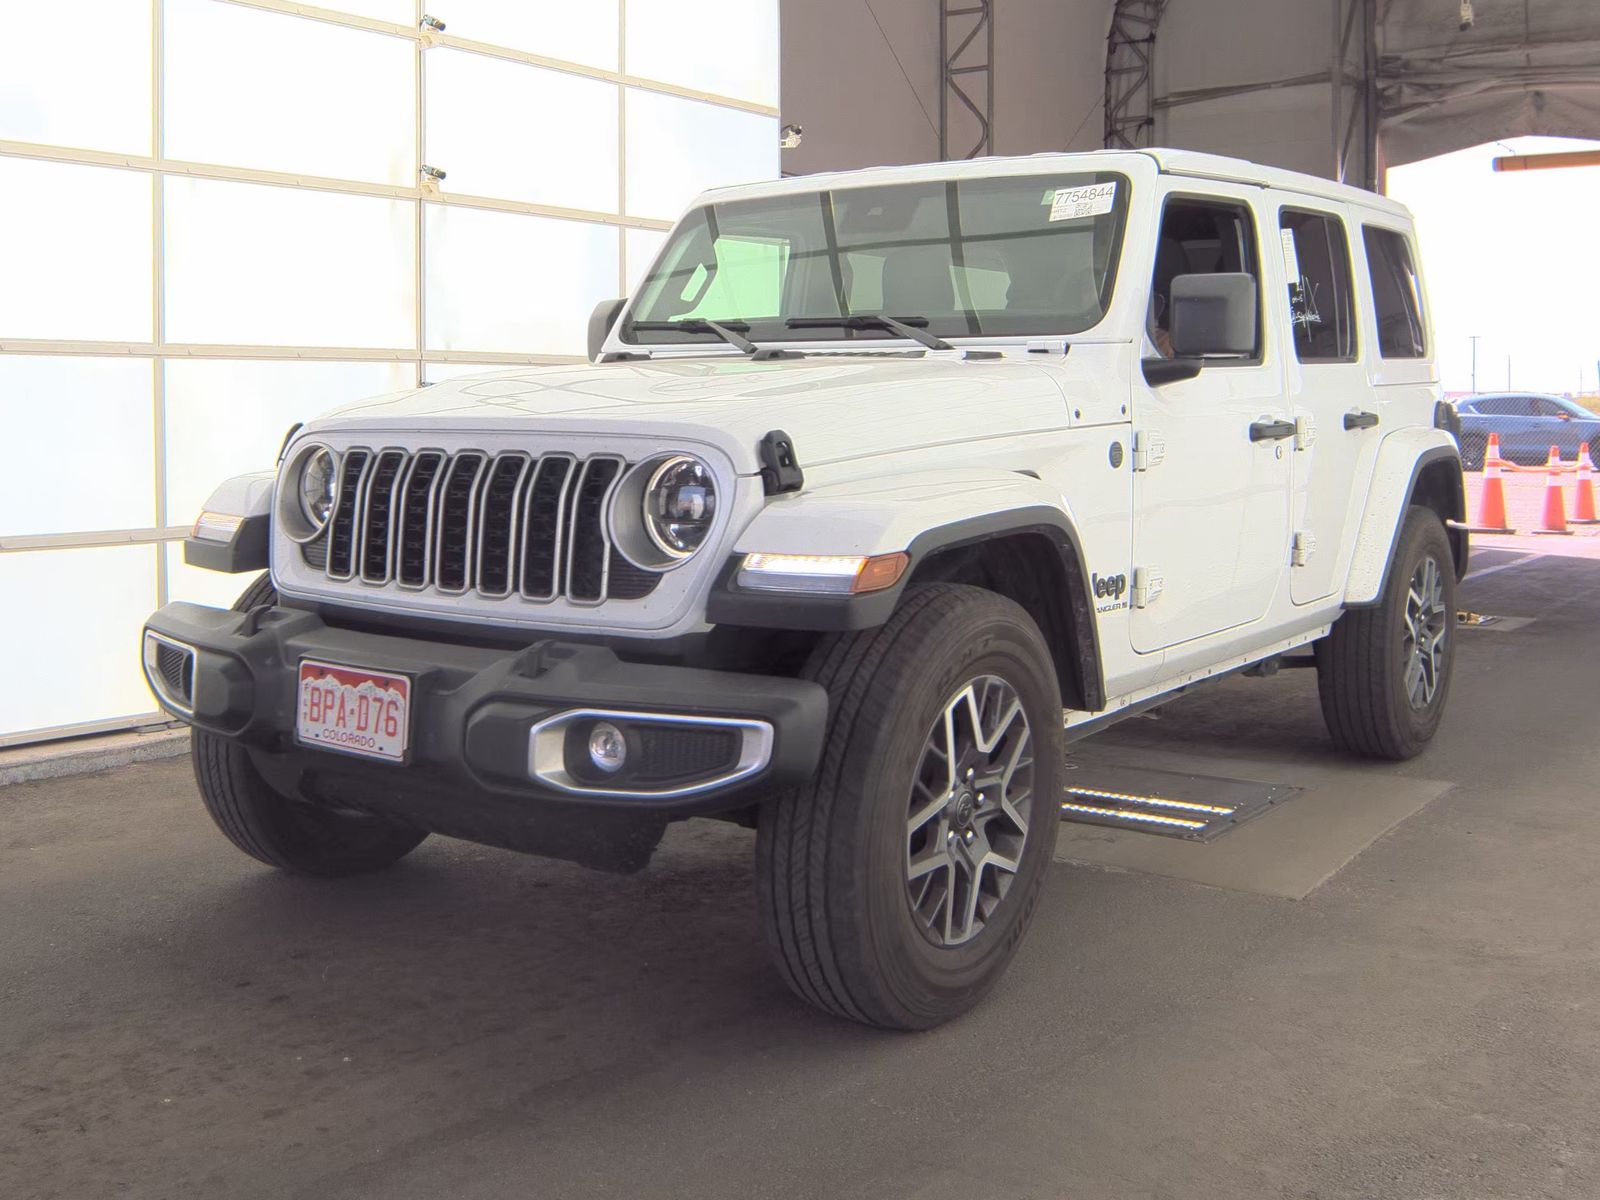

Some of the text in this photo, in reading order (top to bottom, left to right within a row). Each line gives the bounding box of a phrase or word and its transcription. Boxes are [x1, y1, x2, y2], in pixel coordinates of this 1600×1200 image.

[1056, 186, 1114, 205] 7754844
[1092, 572, 1126, 600] Jeep
[322, 728, 376, 748] COLORADO
